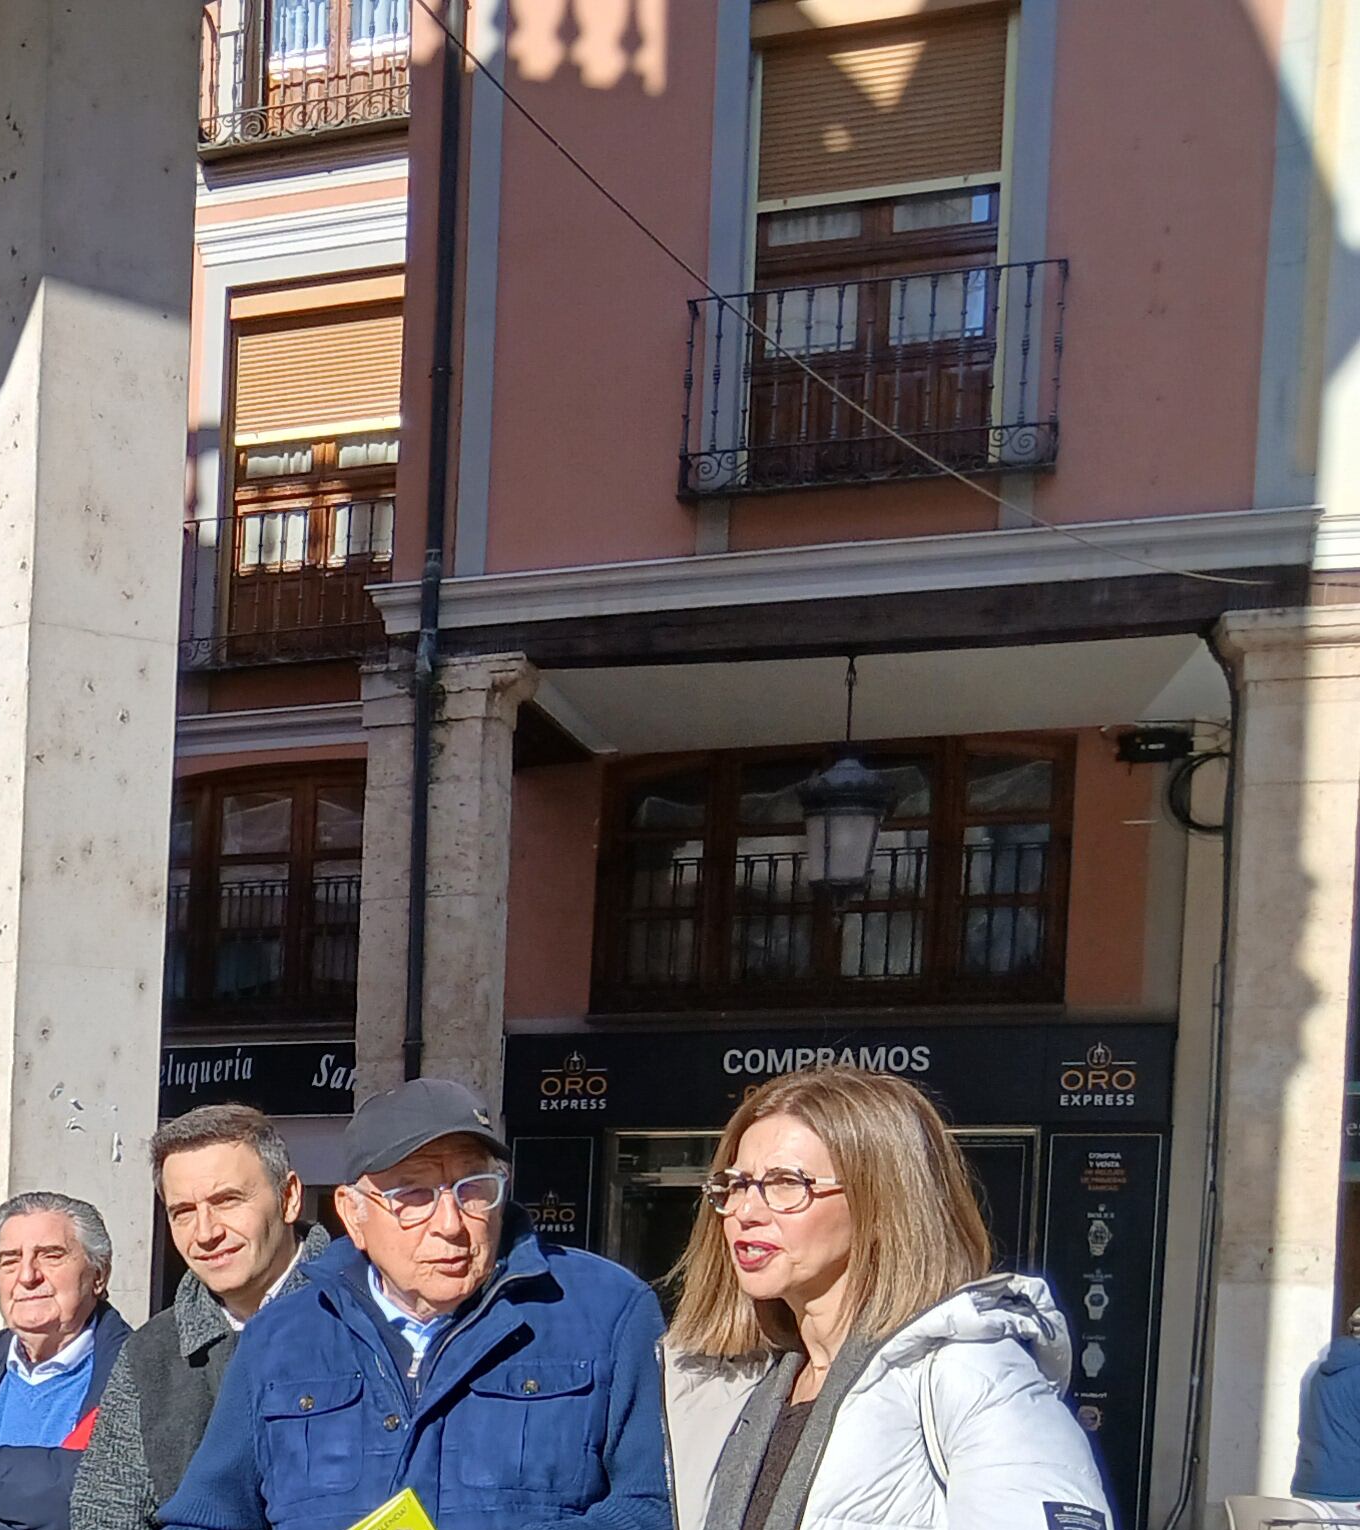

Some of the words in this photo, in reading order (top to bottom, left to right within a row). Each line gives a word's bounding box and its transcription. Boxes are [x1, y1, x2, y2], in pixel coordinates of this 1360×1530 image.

[159, 1048, 253, 1093] eluquería
[723, 1046, 930, 1074] COMPRAMOS
[540, 1076, 608, 1096] ORO
[1060, 1069, 1136, 1091] ORO
[540, 1099, 607, 1110] EXPRESS
[1060, 1094, 1135, 1106] EXPRESS
